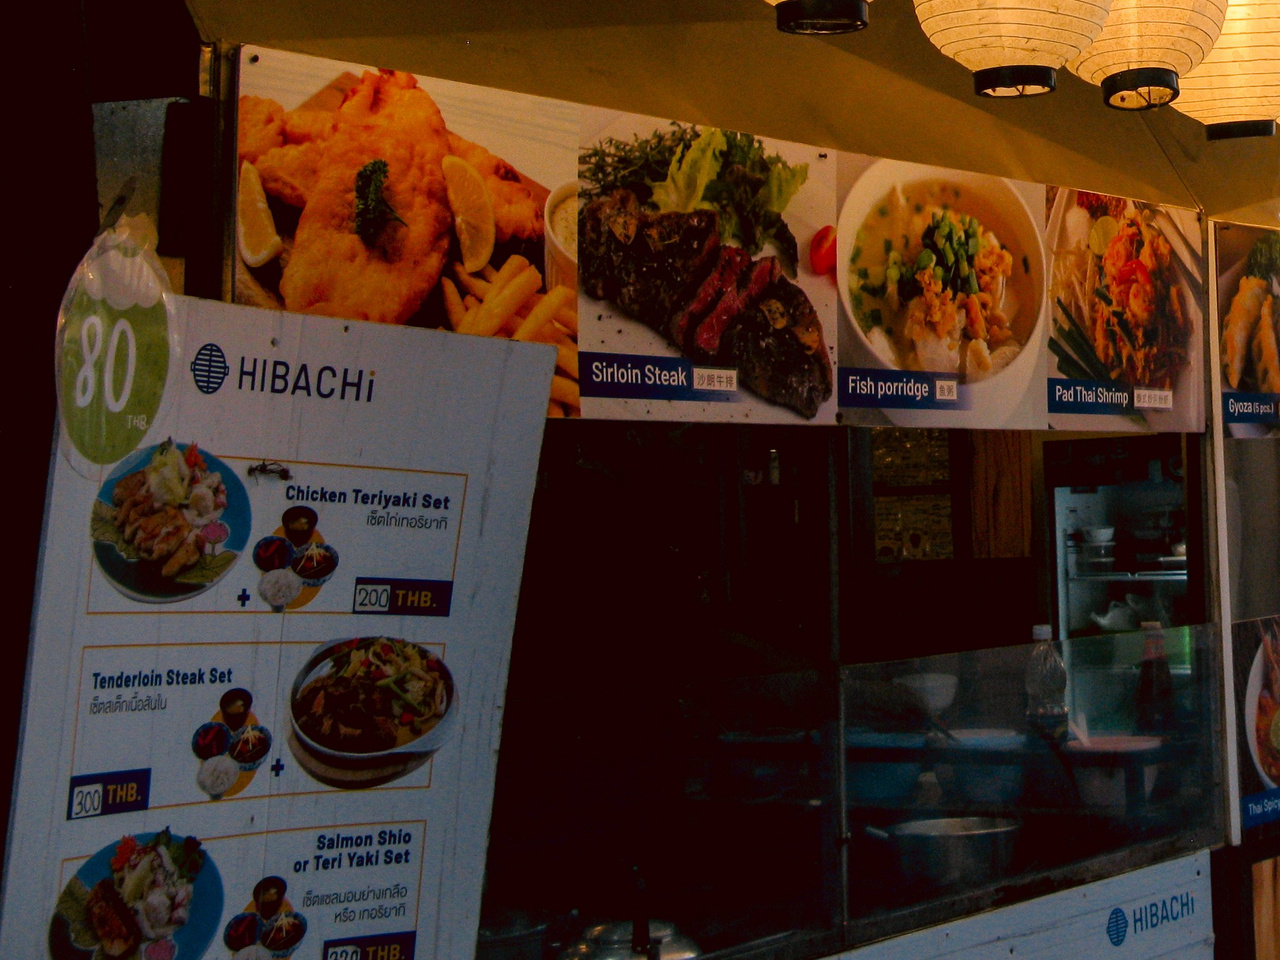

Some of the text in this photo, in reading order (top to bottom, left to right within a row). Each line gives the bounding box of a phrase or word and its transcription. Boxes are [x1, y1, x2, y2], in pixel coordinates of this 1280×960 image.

[75, 315, 137, 413] 80
[591, 361, 688, 387] Sirloin Steak
[848, 375, 929, 401] Fish porridge
[1055, 385, 1129, 408] Pad Thai Shrimp
[1228, 398, 1253, 417] Gyoza
[127, 414, 150, 431] THB.
[286, 484, 451, 511] Chicken Teriyaki Set
[357, 587, 438, 609] 200 THB.
[92, 667, 233, 690] Tenderloin Steak Set
[73, 782, 143, 817] 300 THB.
[1248, 800, 1263, 816] Thai
[316, 828, 413, 851] Salmon Shio
[293, 848, 411, 874] or Teri Yaki Set
[366, 943, 406, 960] THB.
